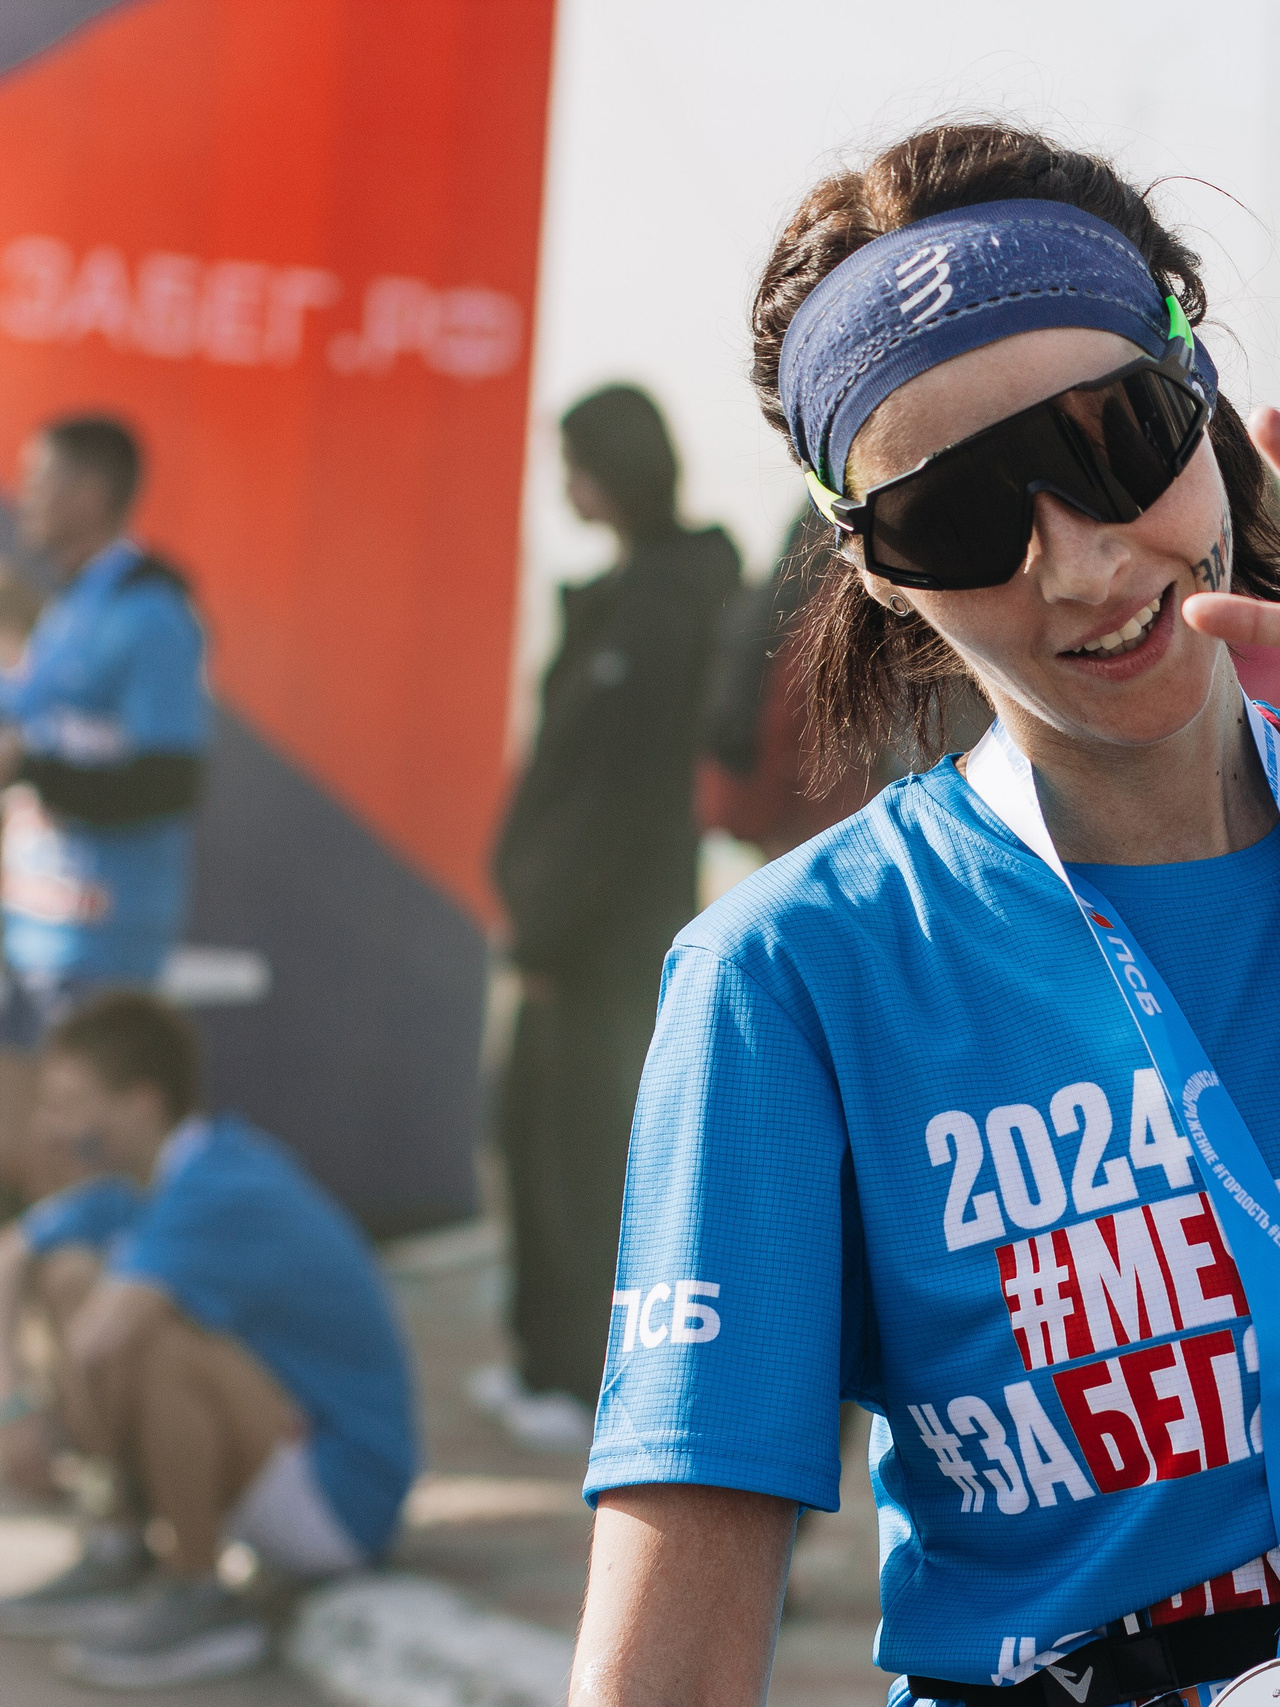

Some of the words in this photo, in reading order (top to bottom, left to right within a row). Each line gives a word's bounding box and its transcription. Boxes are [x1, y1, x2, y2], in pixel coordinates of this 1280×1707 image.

[1107, 935, 1162, 1016] ПСБ
[925, 1068, 1194, 1252] 2024
[1212, 1163, 1271, 1230] #ГОРДОСТЬ
